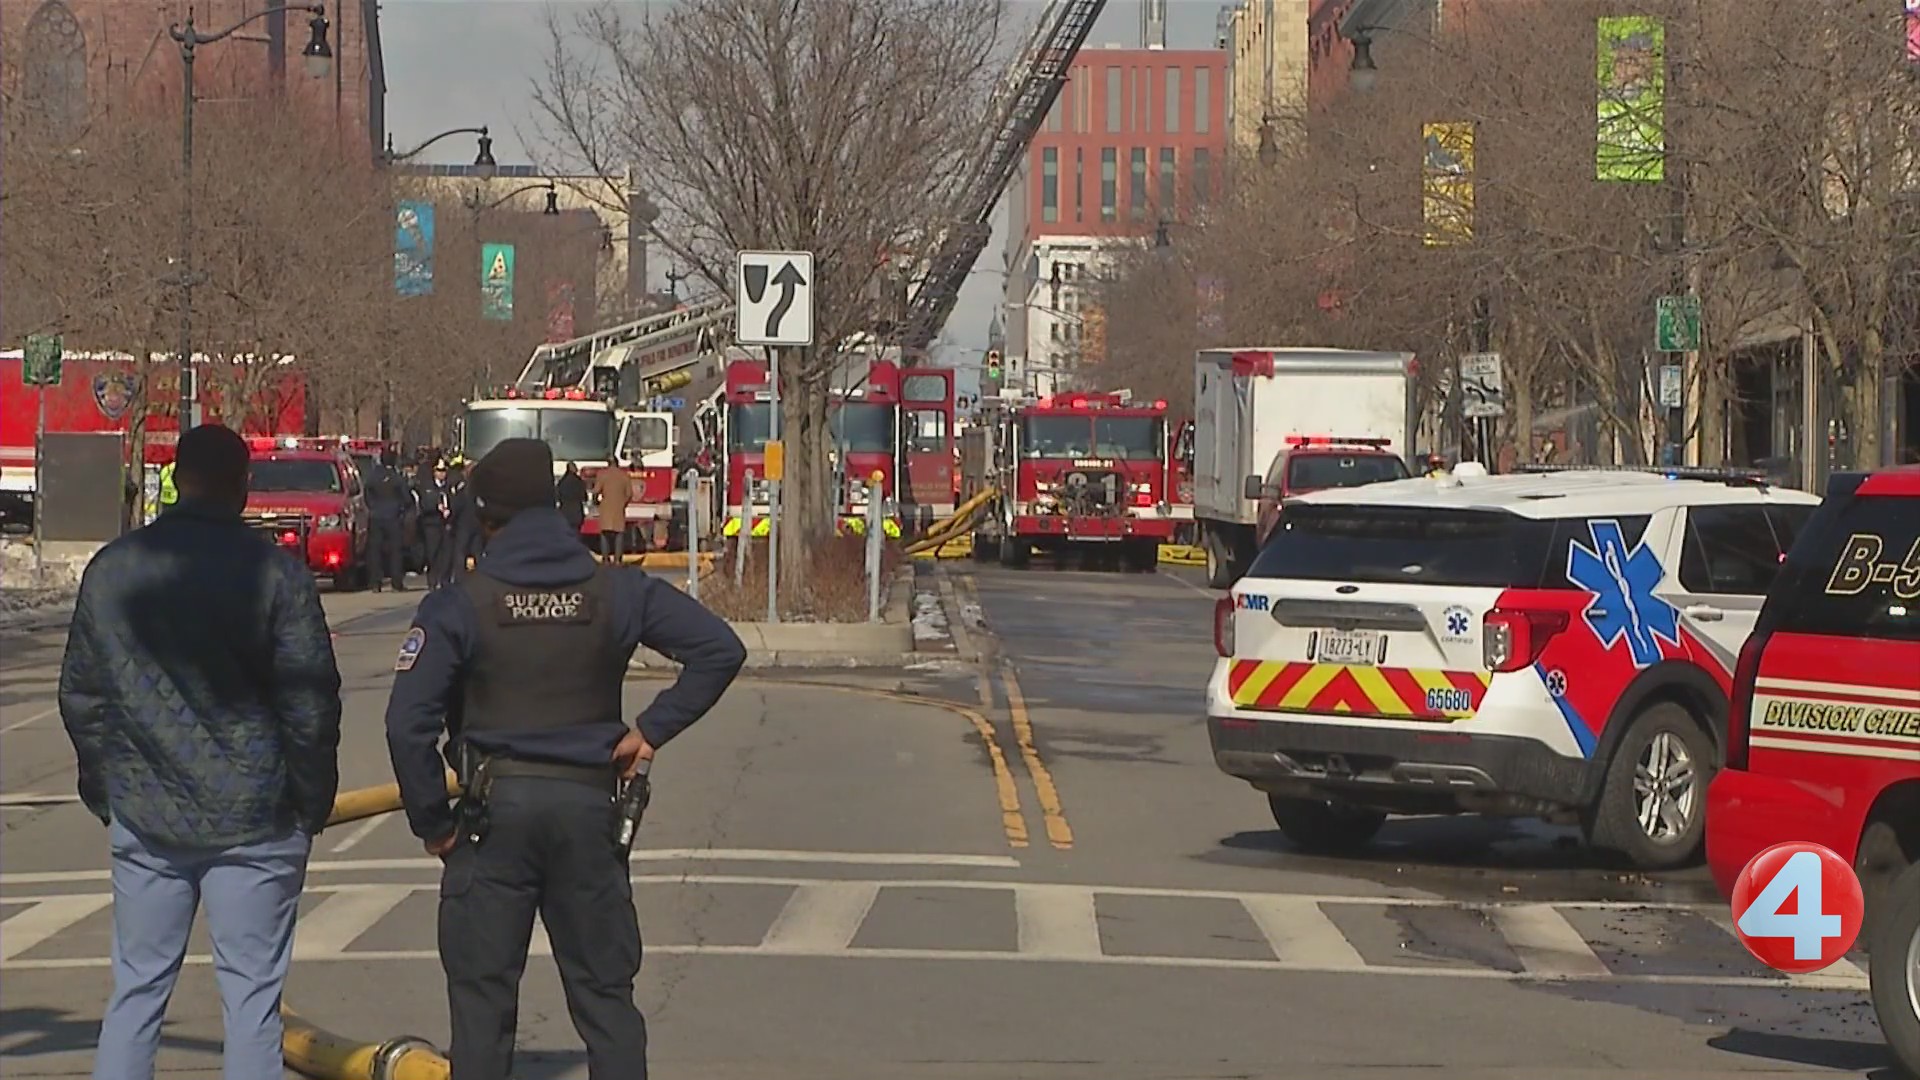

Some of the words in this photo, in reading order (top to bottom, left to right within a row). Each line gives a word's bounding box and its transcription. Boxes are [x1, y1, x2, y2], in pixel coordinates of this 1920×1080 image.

[505, 592, 584, 608] BUFFALO
[511, 605, 578, 619] POLICE
[1426, 687, 1472, 711] 65680
[1763, 700, 1864, 732] DIVISION
[1864, 708, 1920, 738] CHIE
